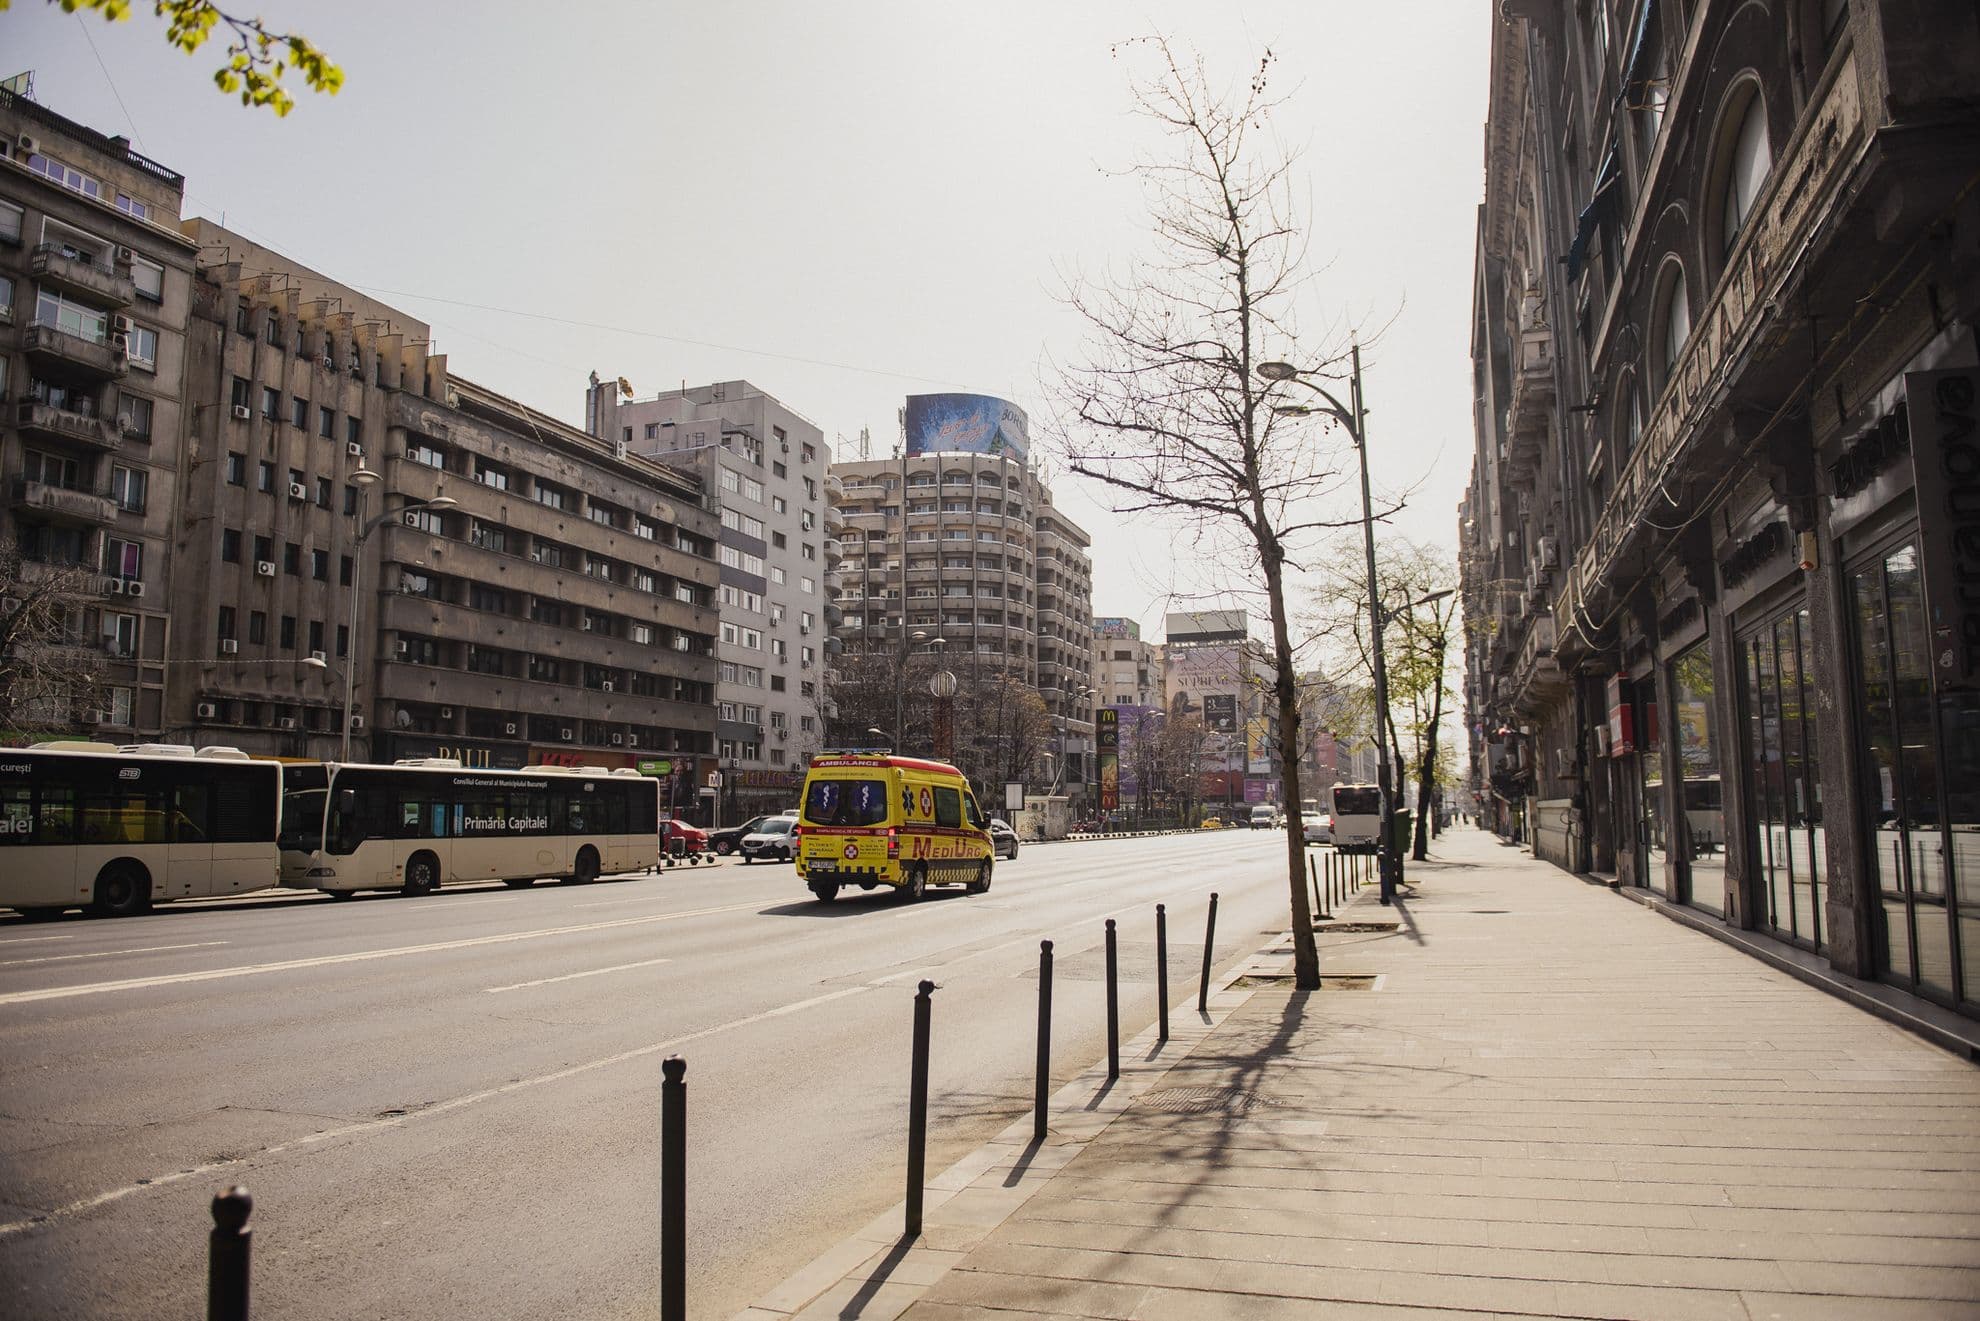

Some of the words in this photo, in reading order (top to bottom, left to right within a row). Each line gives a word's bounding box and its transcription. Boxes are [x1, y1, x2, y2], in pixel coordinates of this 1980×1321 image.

[453, 777, 474, 785] Consiliul
[475, 778, 493, 786] General
[464, 815, 506, 830] Primăria
[508, 815, 548, 832] Capitalei
